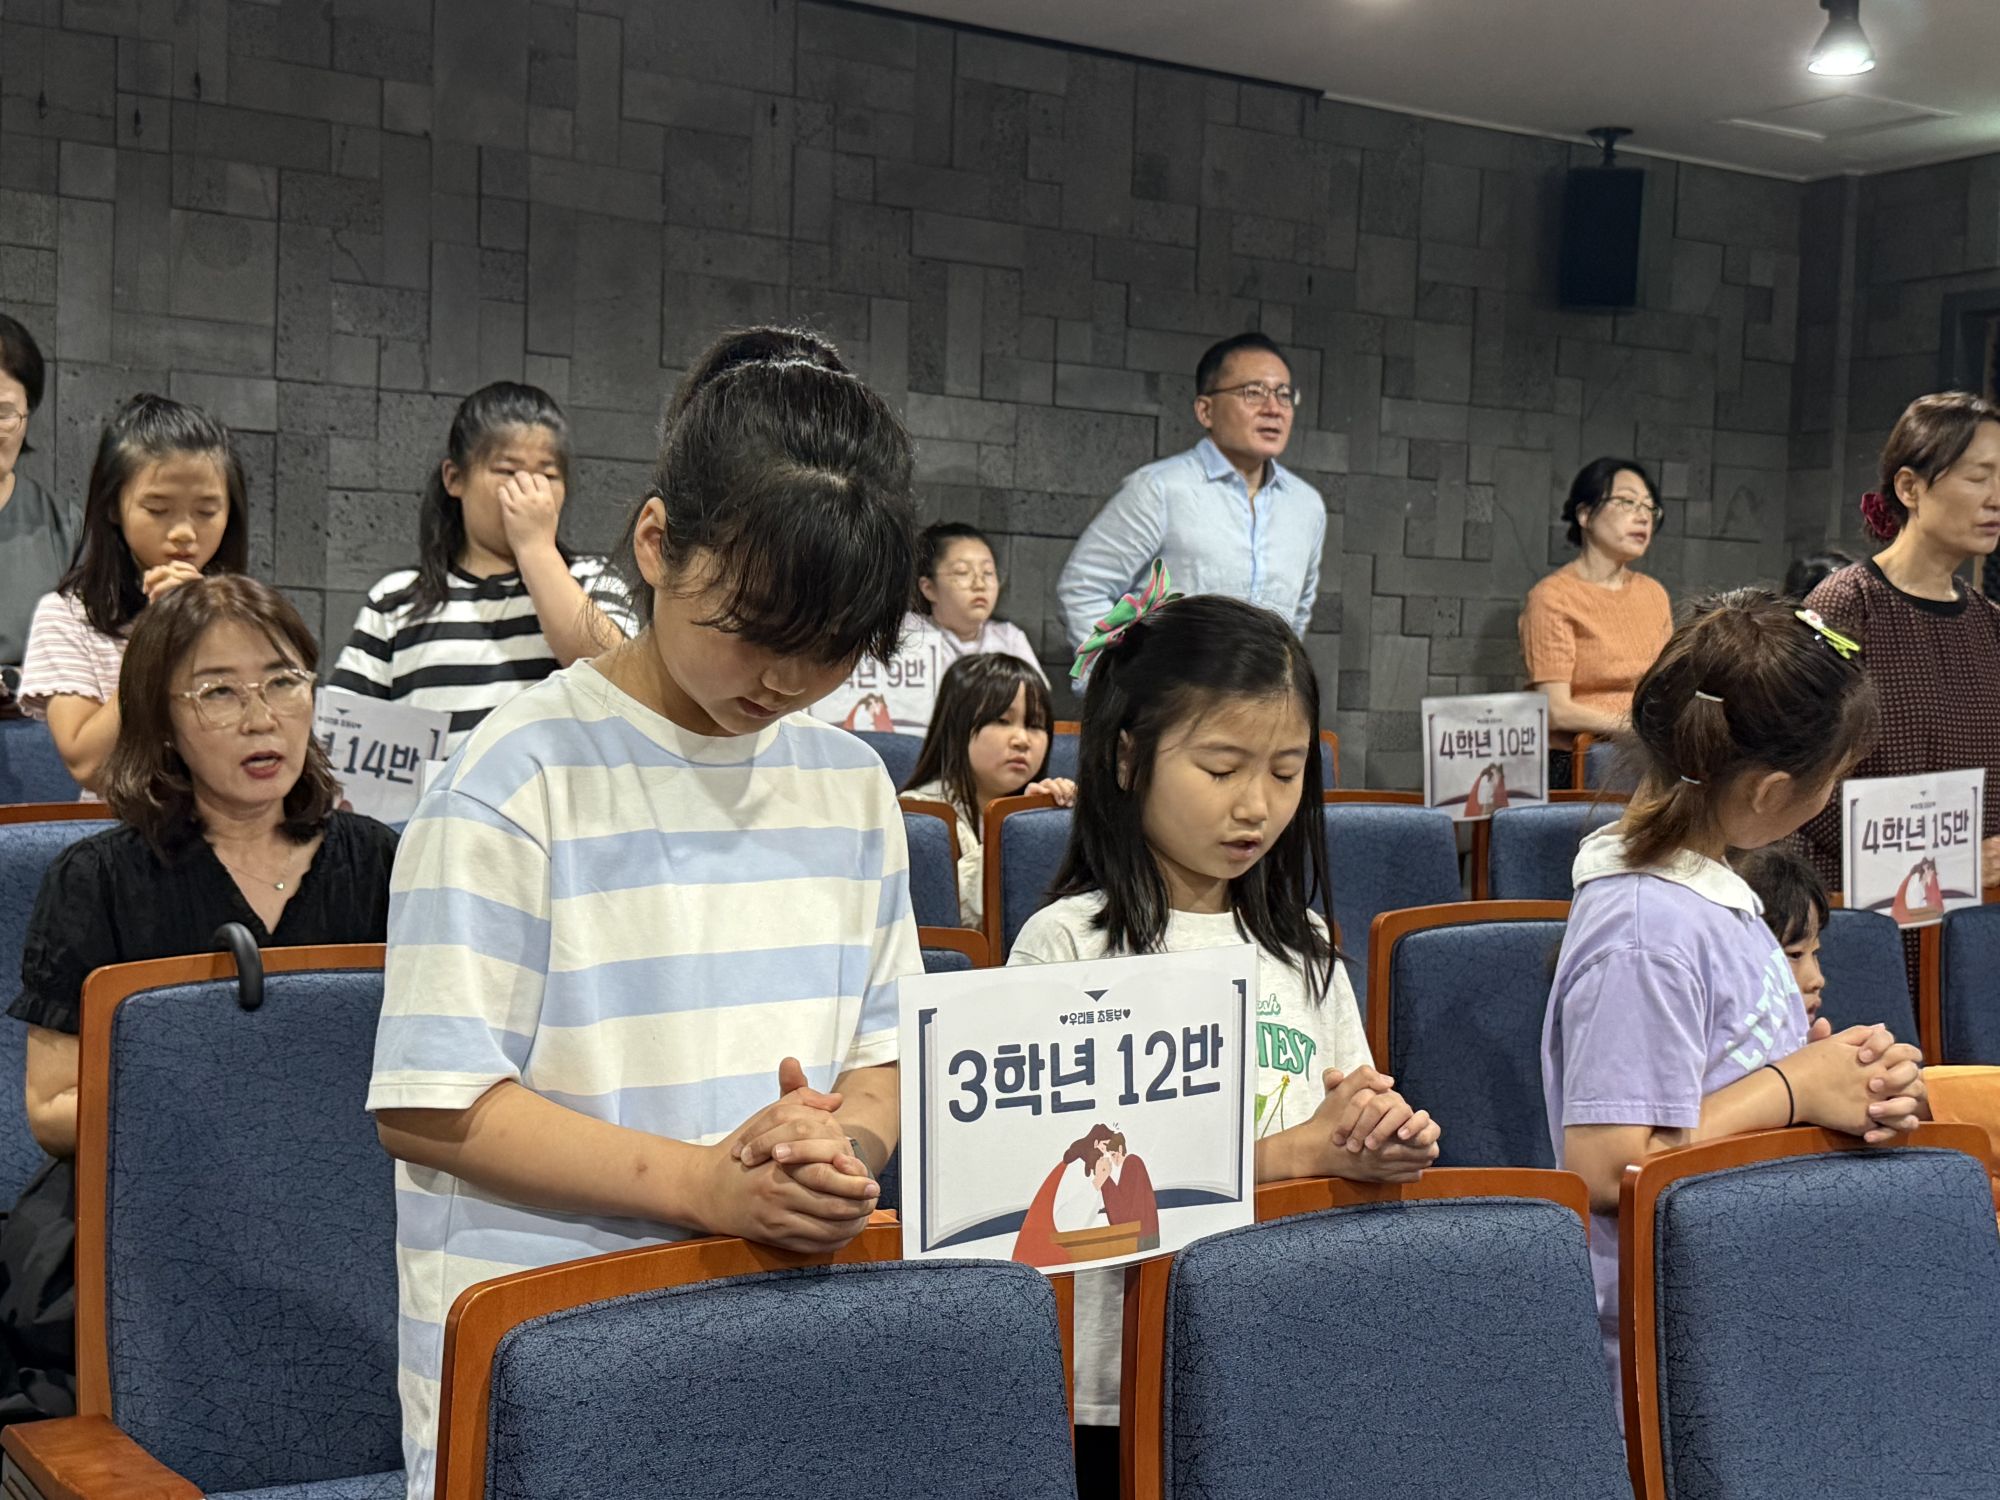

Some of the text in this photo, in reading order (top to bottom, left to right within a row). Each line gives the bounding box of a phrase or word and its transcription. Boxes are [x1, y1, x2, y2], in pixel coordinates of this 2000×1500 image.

[343, 736, 420, 784] 14반
[1440, 727, 1535, 760] 4학년 10반
[1861, 809, 1969, 854] 4학년 15반
[1069, 1009, 1122, 1025] 우리들 초등부
[948, 1023, 1223, 1122] 3학년 12반
